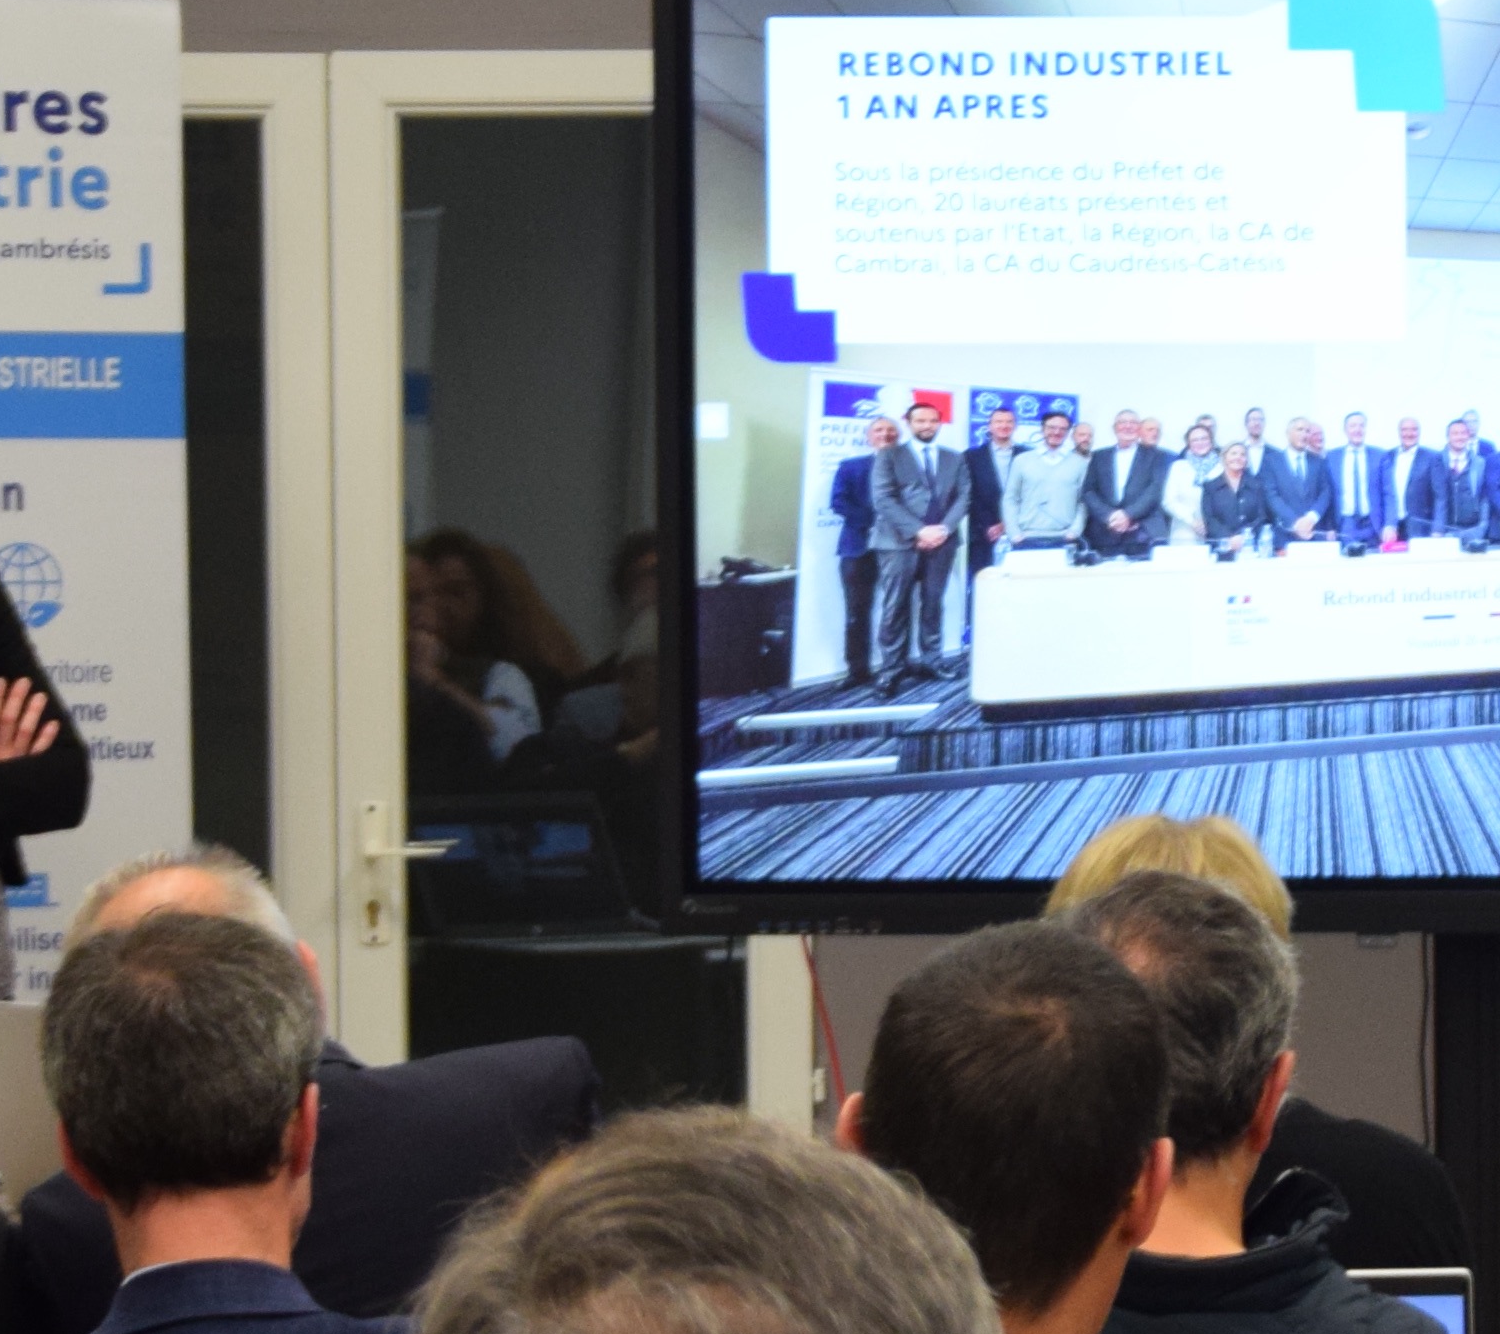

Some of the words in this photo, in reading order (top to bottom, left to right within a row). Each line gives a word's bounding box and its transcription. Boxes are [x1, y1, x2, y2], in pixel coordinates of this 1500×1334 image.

[838, 51, 993, 77] REBOND
[1009, 51, 1232, 77] INDUSTRIEL
[838, 95, 850, 120] 1
[865, 95, 919, 120] AN
[934, 94, 1049, 120] APRES
[834, 162, 892, 182] Sous
[900, 162, 920, 182] la
[928, 161, 1063, 188] présidence
[1072, 162, 1104, 182] du
[1112, 162, 1185, 182] Préfet
[1192, 162, 1225, 182] de
[933, 192, 964, 213] 20
[971, 191, 1068, 212] lauréats
[1077, 192, 1197, 218] présentés
[1203, 194, 1230, 212] et
[834, 225, 946, 243] soutenus
[954, 226, 994, 249] par
[1081, 223, 1103, 243] la
[1208, 223, 1230, 243] la
[1237, 223, 1275, 242] CA
[1283, 223, 1316, 242] de
[955, 254, 975, 274] la
[983, 254, 1020, 274] CA
[1029, 254, 1061, 274] du
[1323, 589, 1396, 606] Rebond
